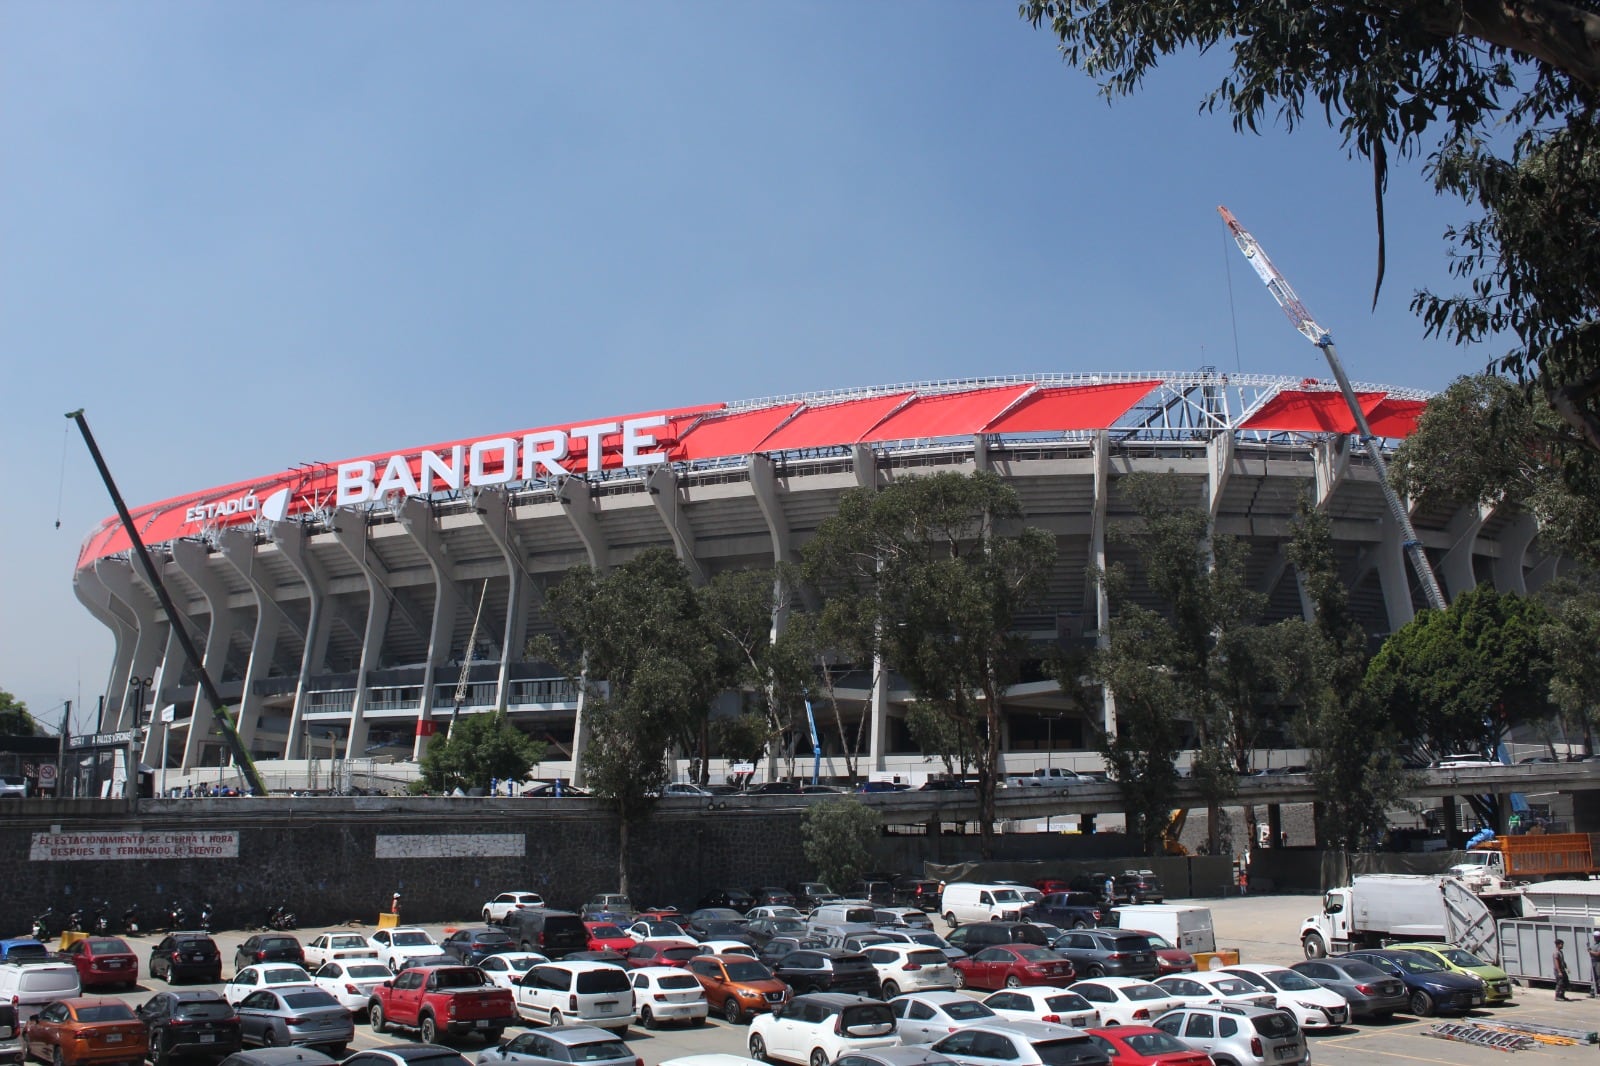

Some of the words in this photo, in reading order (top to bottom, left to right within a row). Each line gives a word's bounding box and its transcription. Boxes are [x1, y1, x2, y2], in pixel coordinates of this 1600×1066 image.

[336, 415, 669, 506] BANORTE
[40, 836, 50, 845] EL
[54, 835, 145, 845] ESTACIONAMIENTO
[149, 835, 160, 844] SE
[165, 835, 198, 844] CIERRA
[209, 835, 233, 843] HORA
[51, 847, 95, 856] DESPUES
[100, 847, 111, 855] DE
[117, 847, 170, 855] TERMINADO
[188, 846, 222, 854] EVENTO
